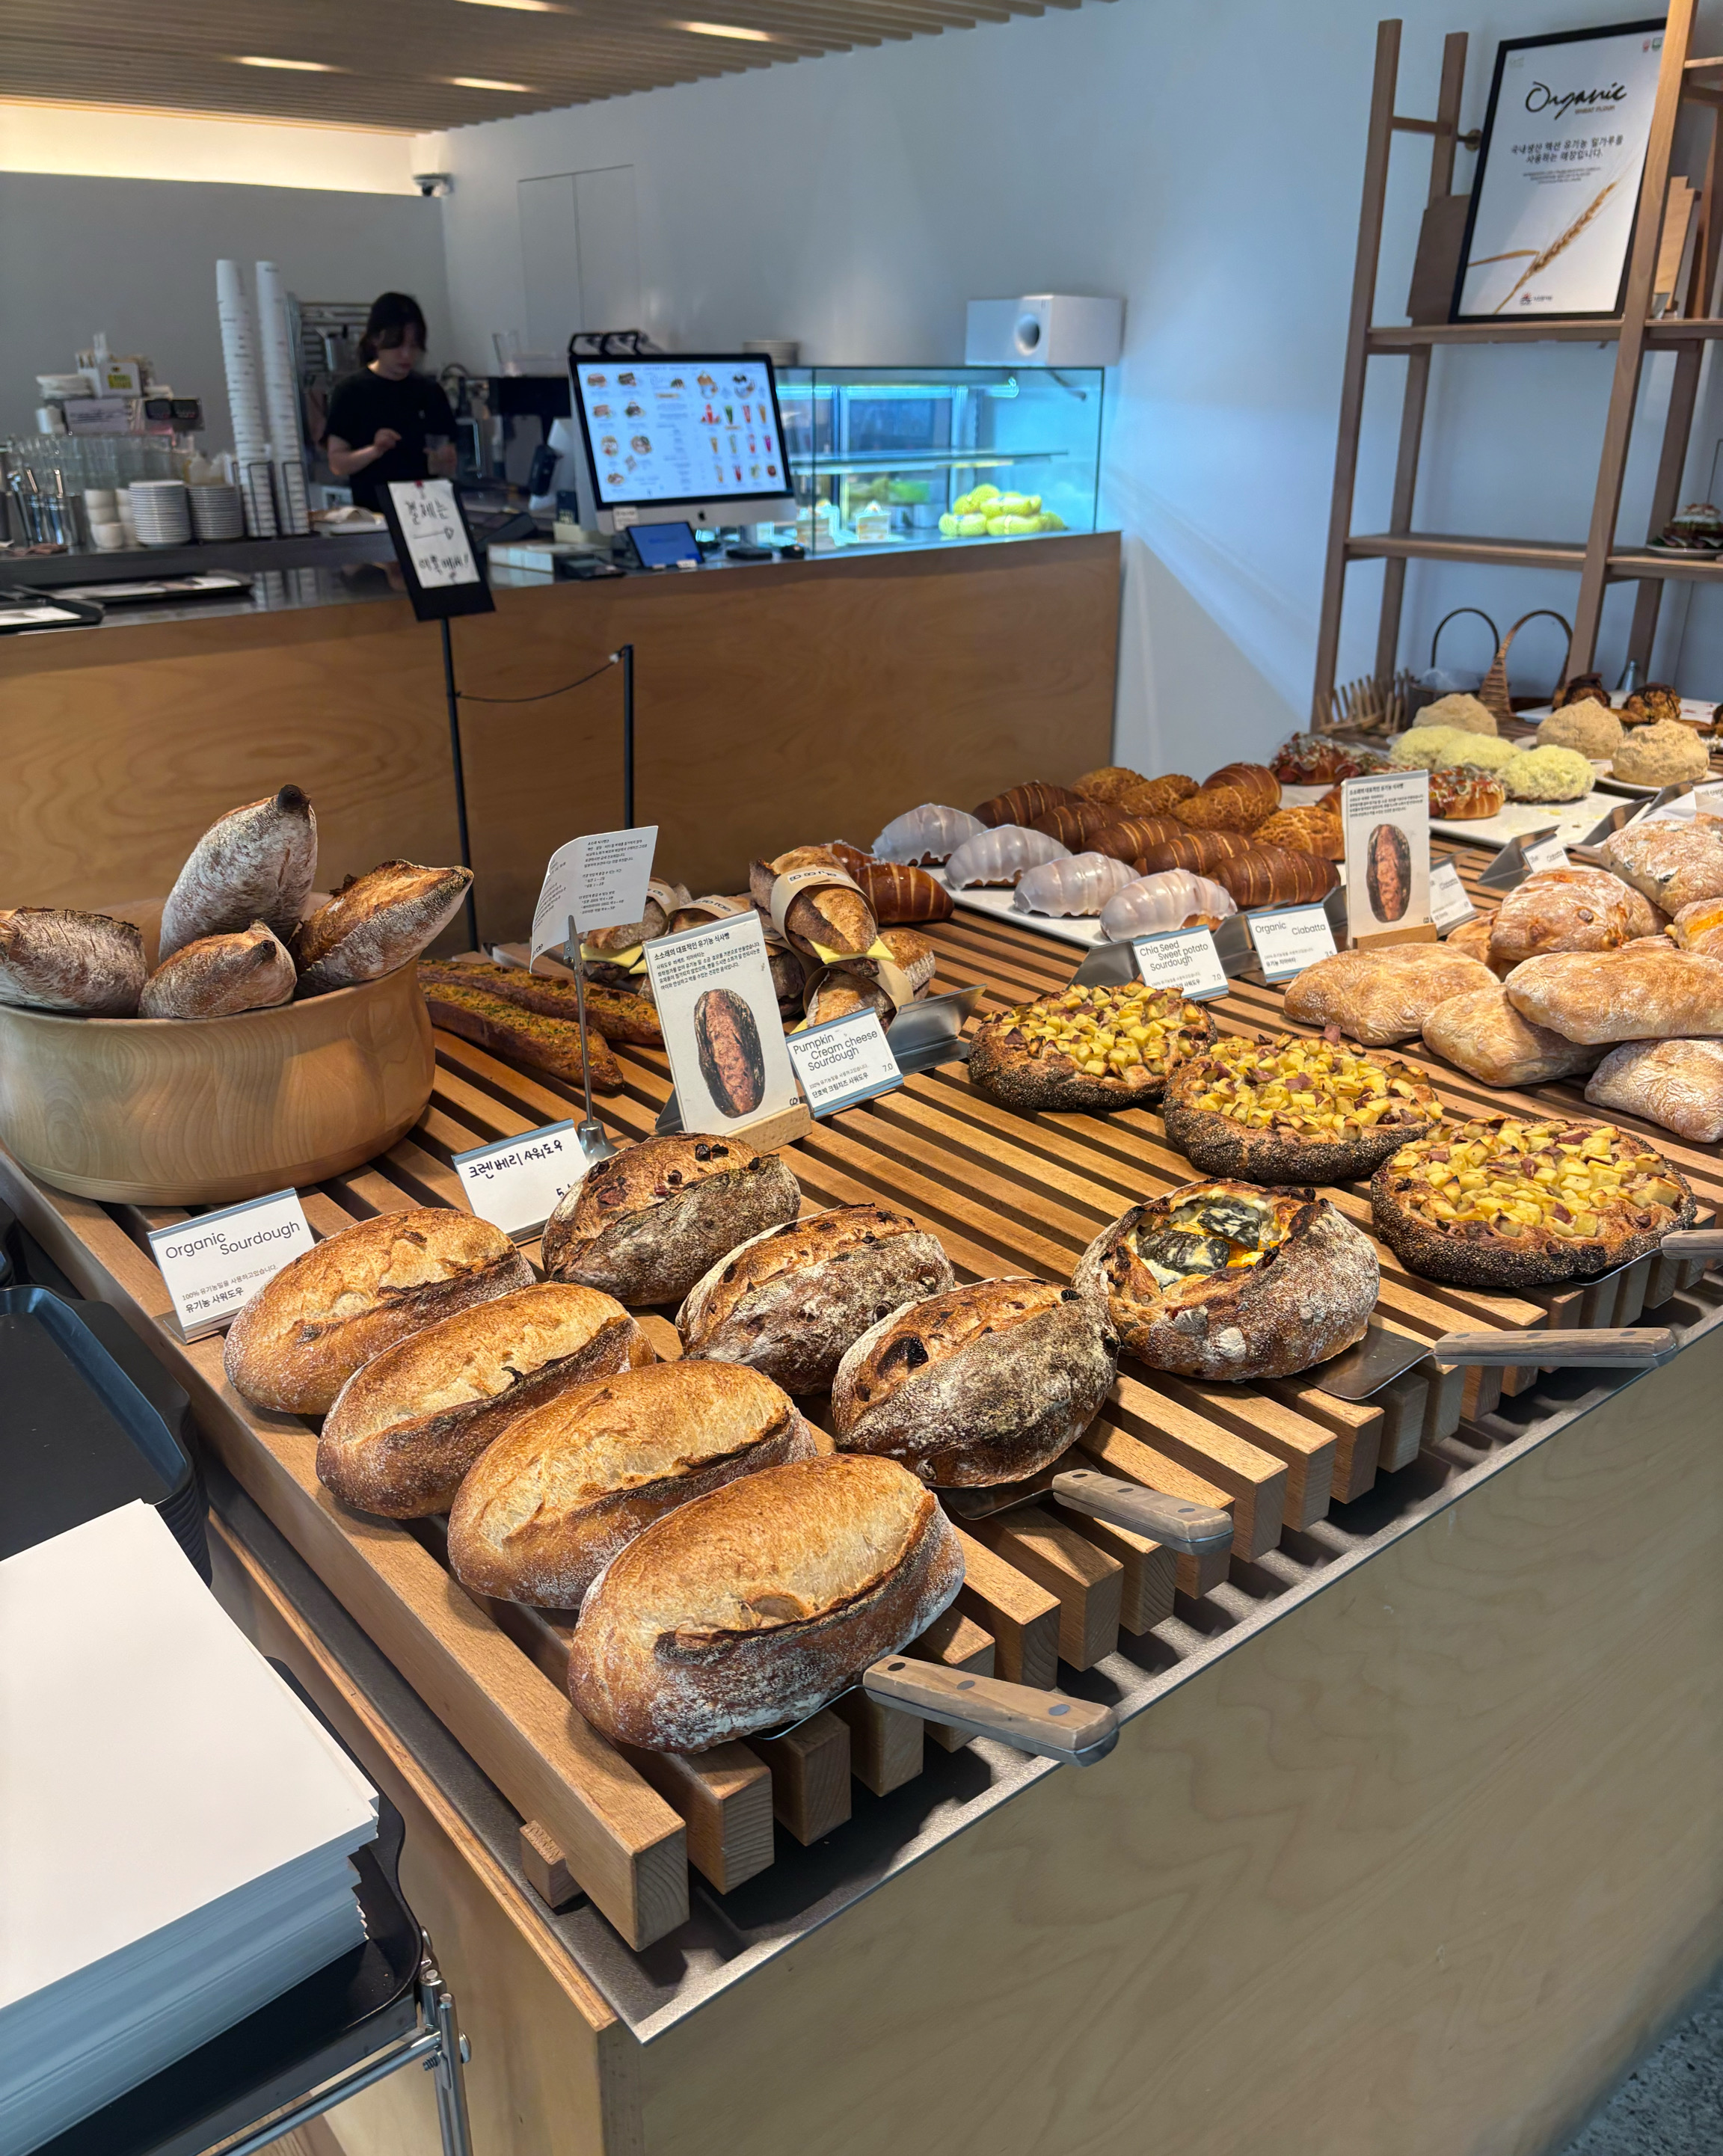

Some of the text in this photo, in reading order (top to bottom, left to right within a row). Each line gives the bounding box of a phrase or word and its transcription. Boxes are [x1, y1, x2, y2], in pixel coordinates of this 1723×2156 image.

[1526, 81, 1627, 120] Organic
[1256, 921, 1326, 935] Organic Ciabatta
[654, 933, 730, 960] 소소래의 대표적인 유기농 식사빵
[1140, 940, 1179, 956] Chia Seed
[1158, 943, 1208, 961] Sweet potato
[1150, 956, 1193, 971] Sourdough
[793, 1034, 835, 1054] Pumpkin
[811, 1031, 878, 1060] Cream cheese
[808, 1047, 859, 1071] Sourdough
[882, 1063, 893, 1072] 7.0
[812, 1087, 829, 1099] 단호박
[849, 1072, 868, 1084] 사워도우
[468, 1140, 563, 1179] 크렌베리 사워도우
[166, 1232, 226, 1258] Organic
[220, 1221, 300, 1255] Sourdough
[182, 1291, 200, 1300] 100%
[185, 1287, 244, 1313] 유기농 사워도우
